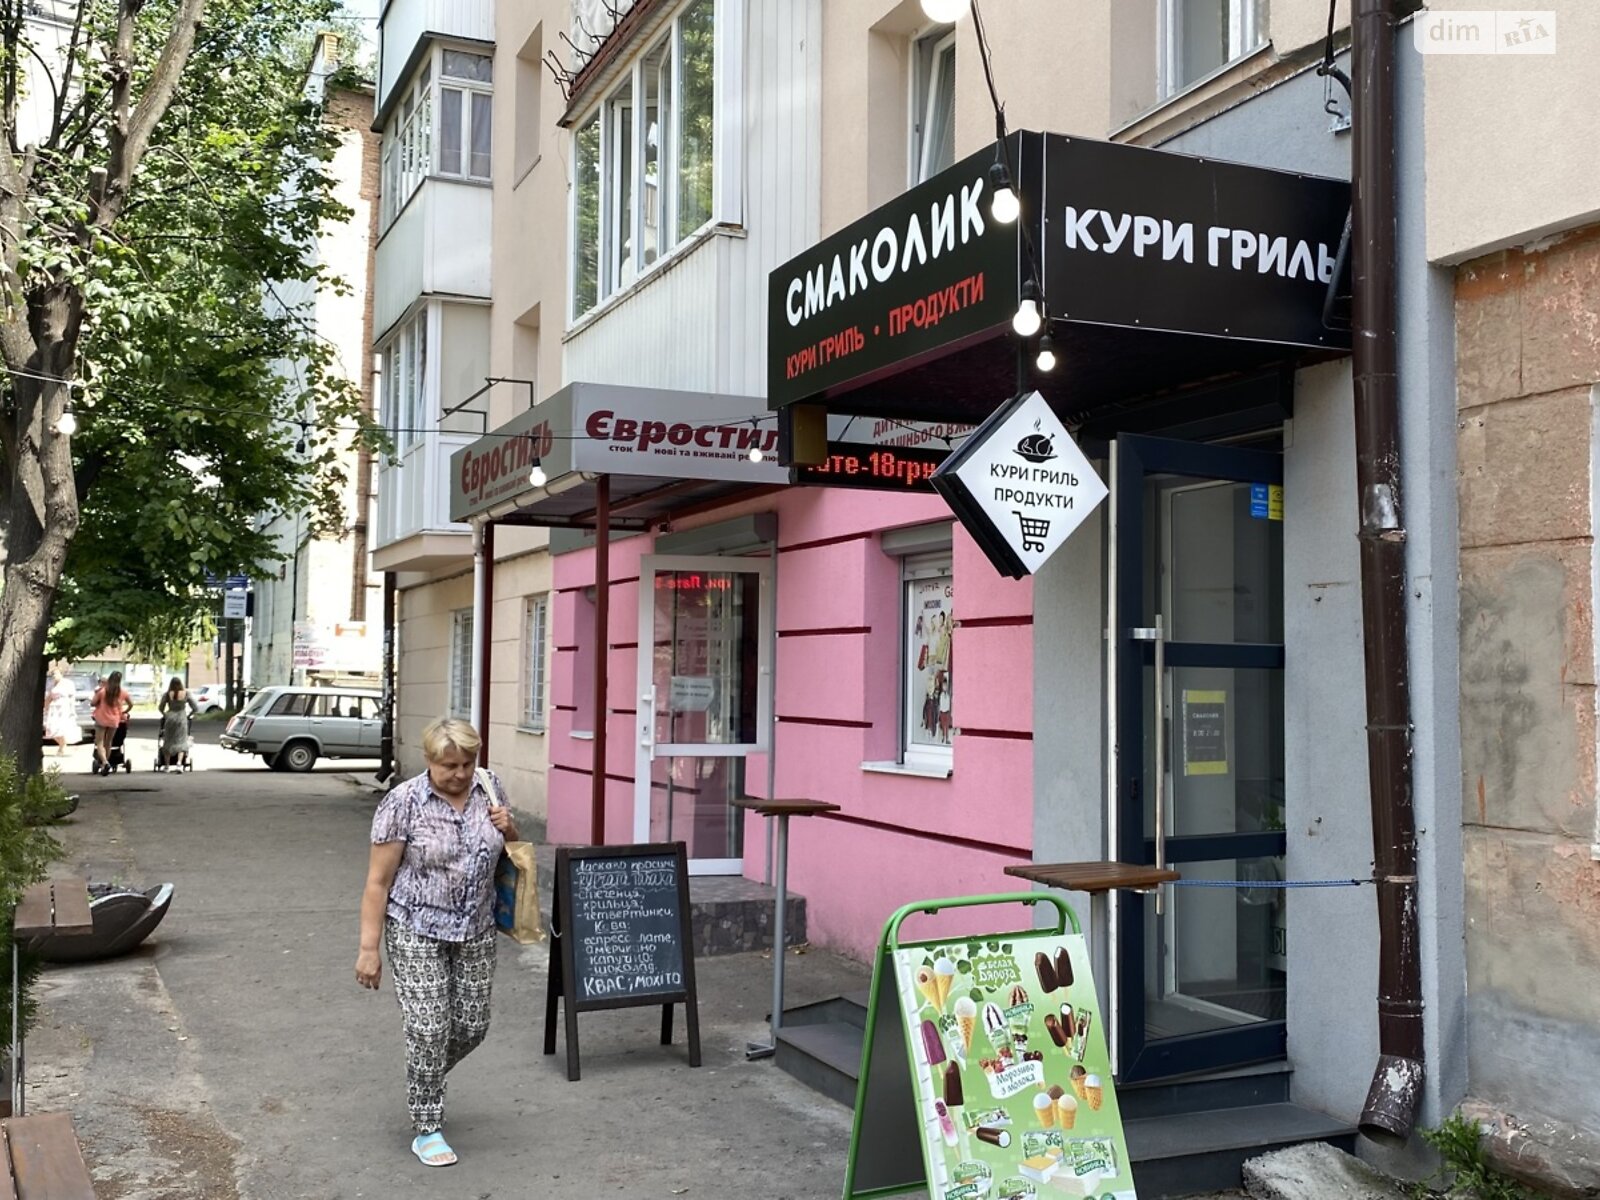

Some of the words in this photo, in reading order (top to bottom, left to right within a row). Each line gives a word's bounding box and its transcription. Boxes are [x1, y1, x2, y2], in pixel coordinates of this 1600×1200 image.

[786, 176, 985, 327] СМАКОЛИК
[1065, 206, 1194, 264] КУРИ
[1208, 226, 1338, 284] ГРИЛЬ
[786, 345, 816, 380] КУРИ
[819, 326, 865, 365] ГРИЛЬ
[889, 272, 984, 337] ПРОДУКТИ
[585, 410, 779, 452] Євростил
[608, 445, 633, 453] сток
[654, 447, 677, 456] нові
[679, 449, 691, 457] та
[693, 451, 736, 460] вживані
[808, 451, 937, 486] те-18грн
[990, 463, 1029, 481] КУРИ
[1032, 468, 1079, 487] ГРИЛЬ
[994, 487, 1074, 510] ПРОДУКТИ
[996, 1063, 1035, 1085] Морозиво
[1008, 1073, 1036, 1092] молока
